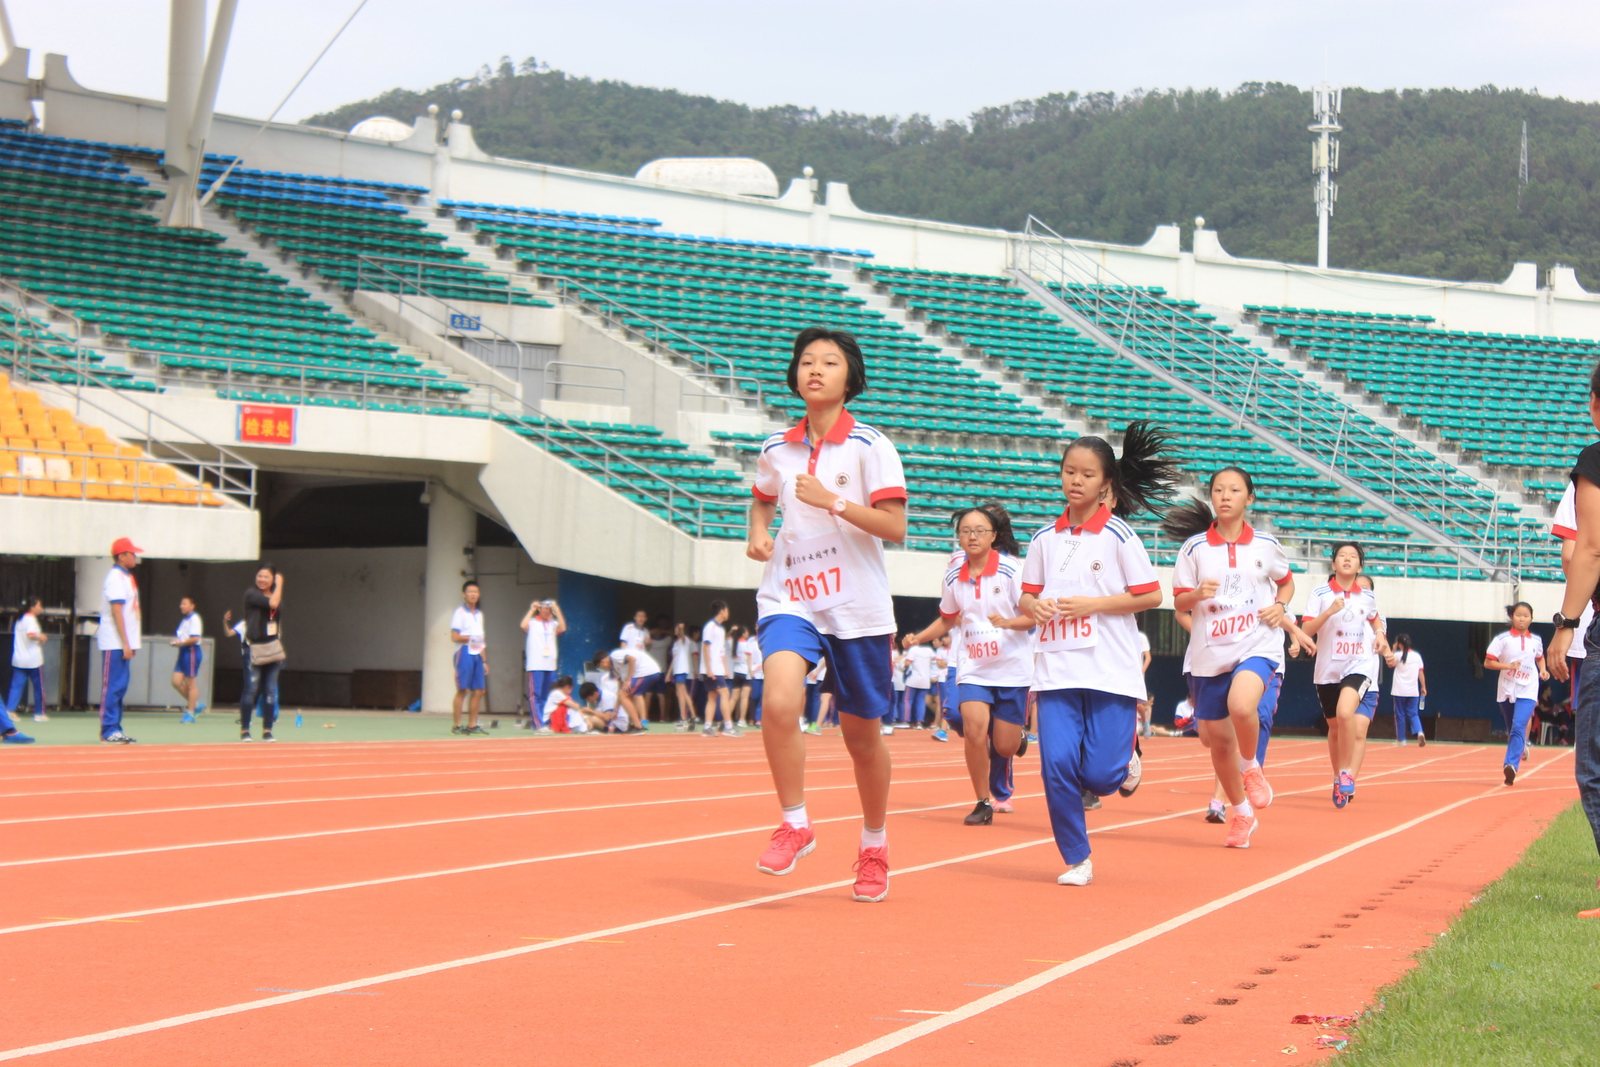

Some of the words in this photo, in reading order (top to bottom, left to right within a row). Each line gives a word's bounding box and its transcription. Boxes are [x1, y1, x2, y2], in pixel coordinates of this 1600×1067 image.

[245, 418, 290, 438] 检录处
[785, 567, 841, 602] 21617
[1040, 616, 1092, 643] 21115
[1211, 613, 1254, 637] 20720
